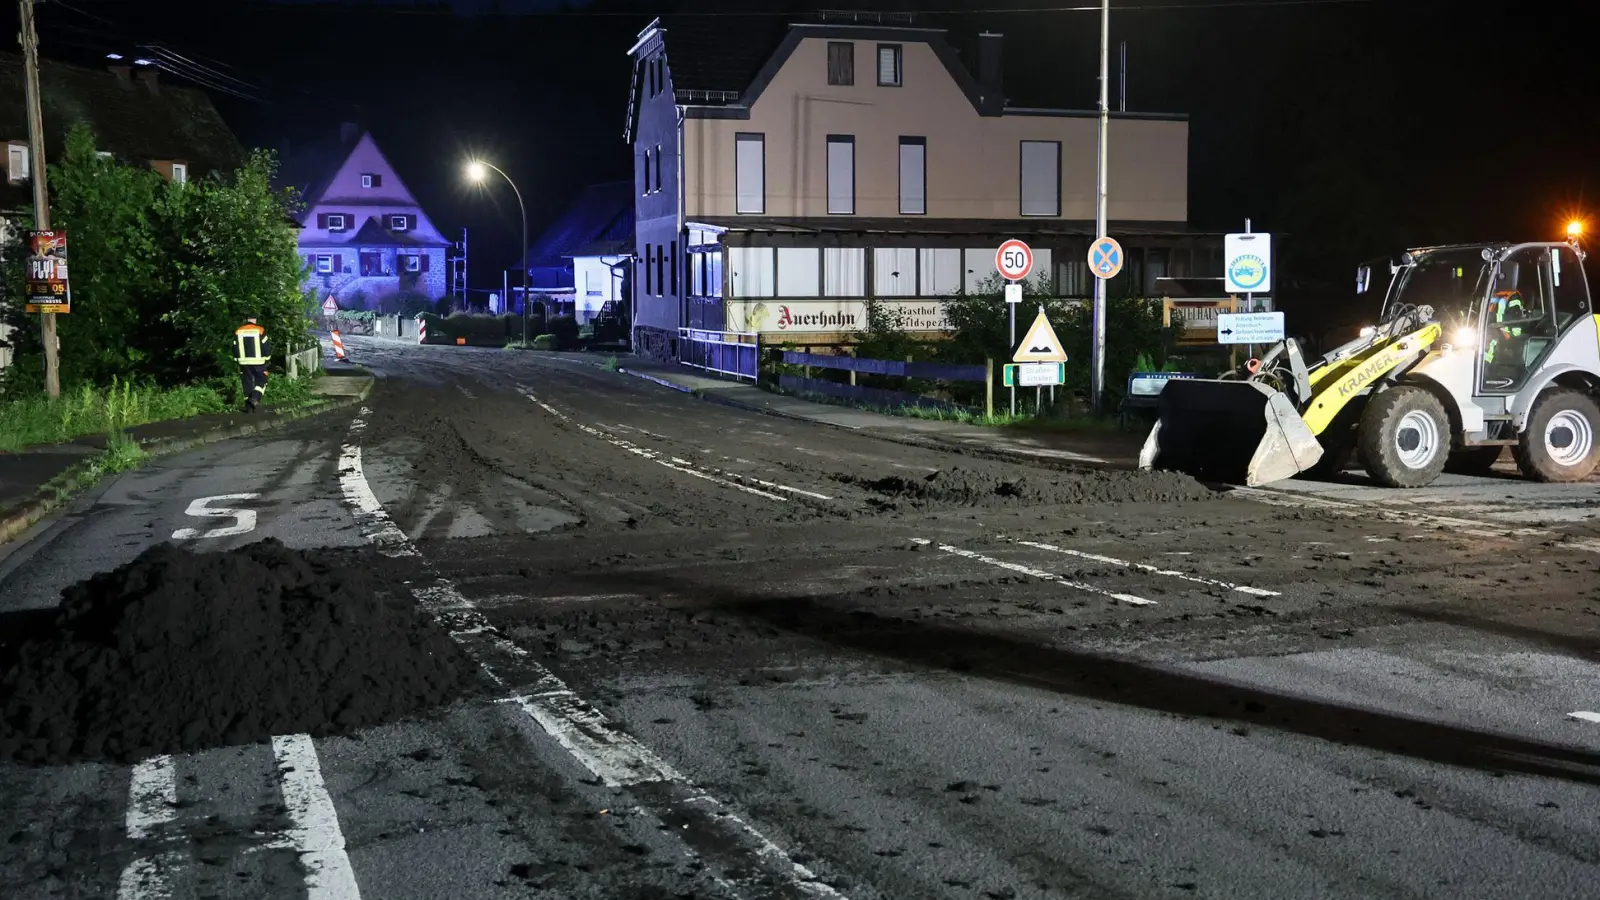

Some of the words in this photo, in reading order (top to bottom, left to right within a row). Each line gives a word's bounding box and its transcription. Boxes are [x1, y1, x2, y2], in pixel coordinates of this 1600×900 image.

[32, 260, 54, 279] FLY!
[1005, 252, 1024, 268] 50
[777, 305, 855, 329] Auerhahn
[898, 306, 936, 315] Gasthof
[1338, 353, 1392, 396] KRAMER
